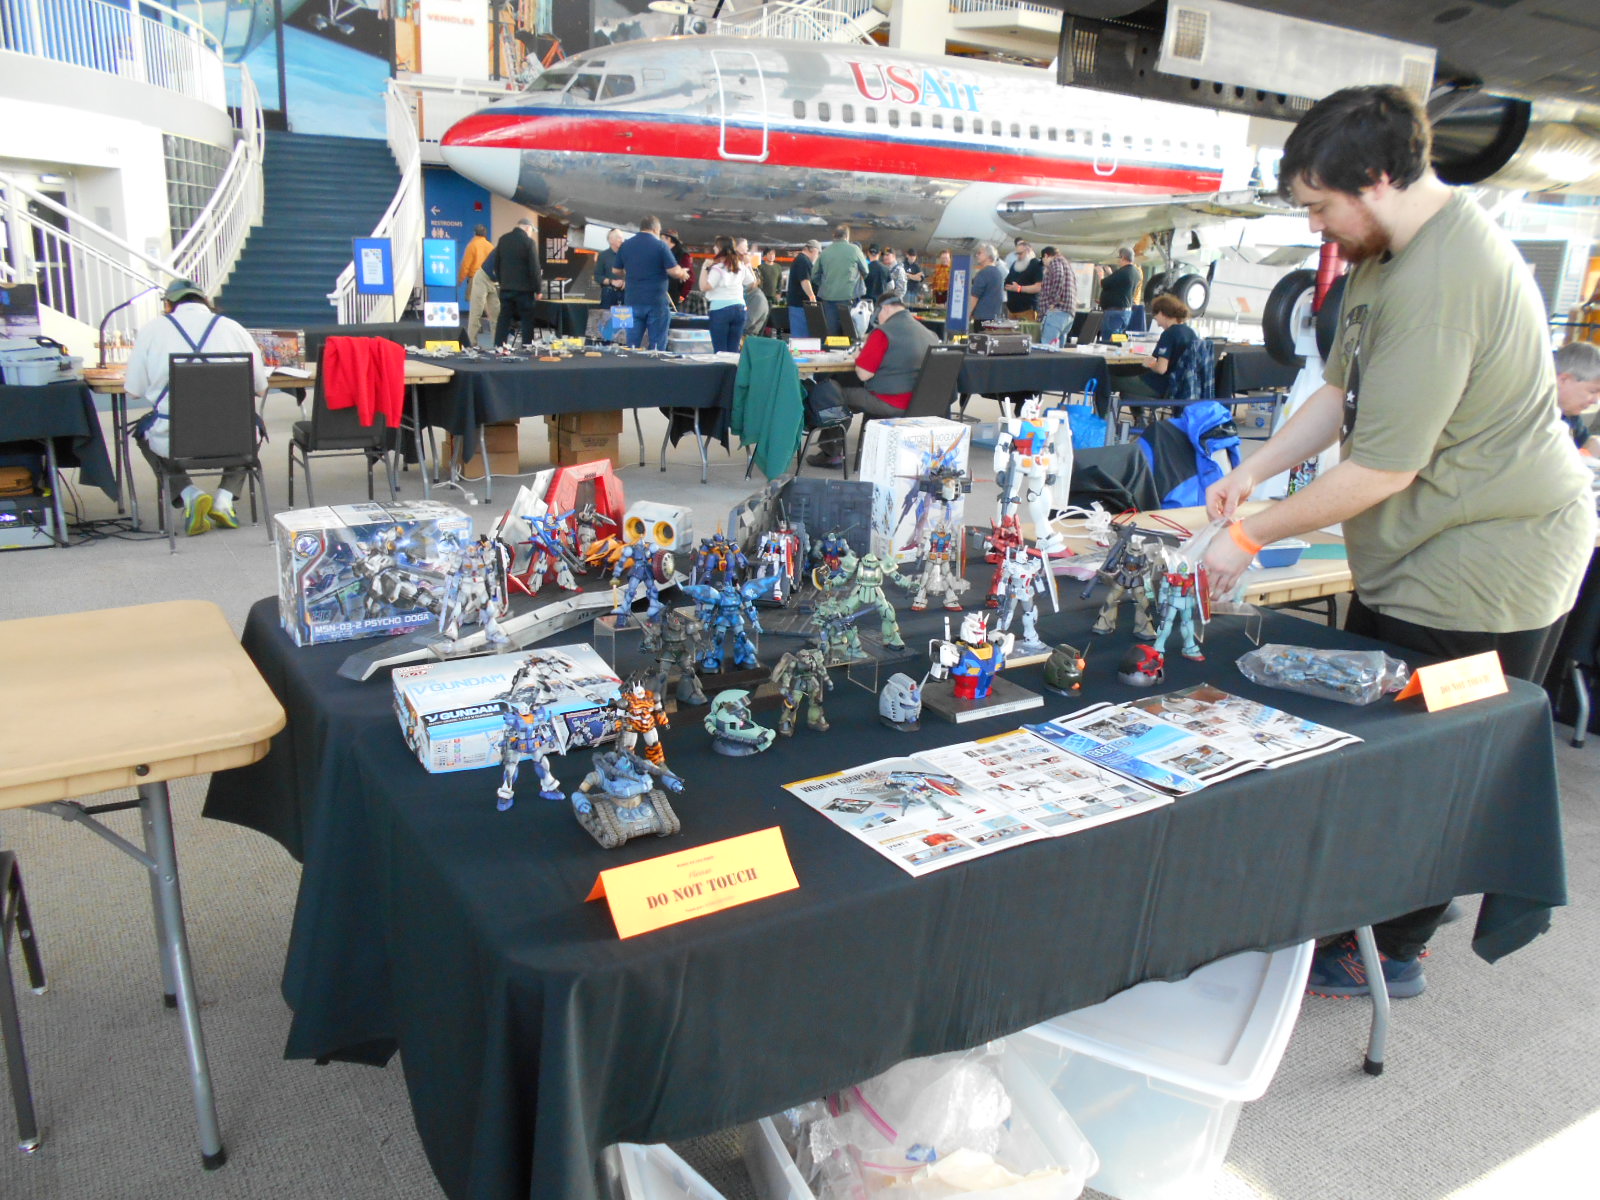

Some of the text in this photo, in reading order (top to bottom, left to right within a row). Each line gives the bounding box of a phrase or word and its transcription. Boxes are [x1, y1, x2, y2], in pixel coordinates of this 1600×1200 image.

[846, 61, 982, 112] USAir
[314, 613, 429, 634] MSN-03-2 PSYCHO DOGA
[431, 673, 506, 692] GUNDAM
[440, 703, 500, 720] GUNDAM
[646, 893, 669, 909] DO
[672, 882, 703, 902] NOT
[706, 867, 758, 892] TOUCH
